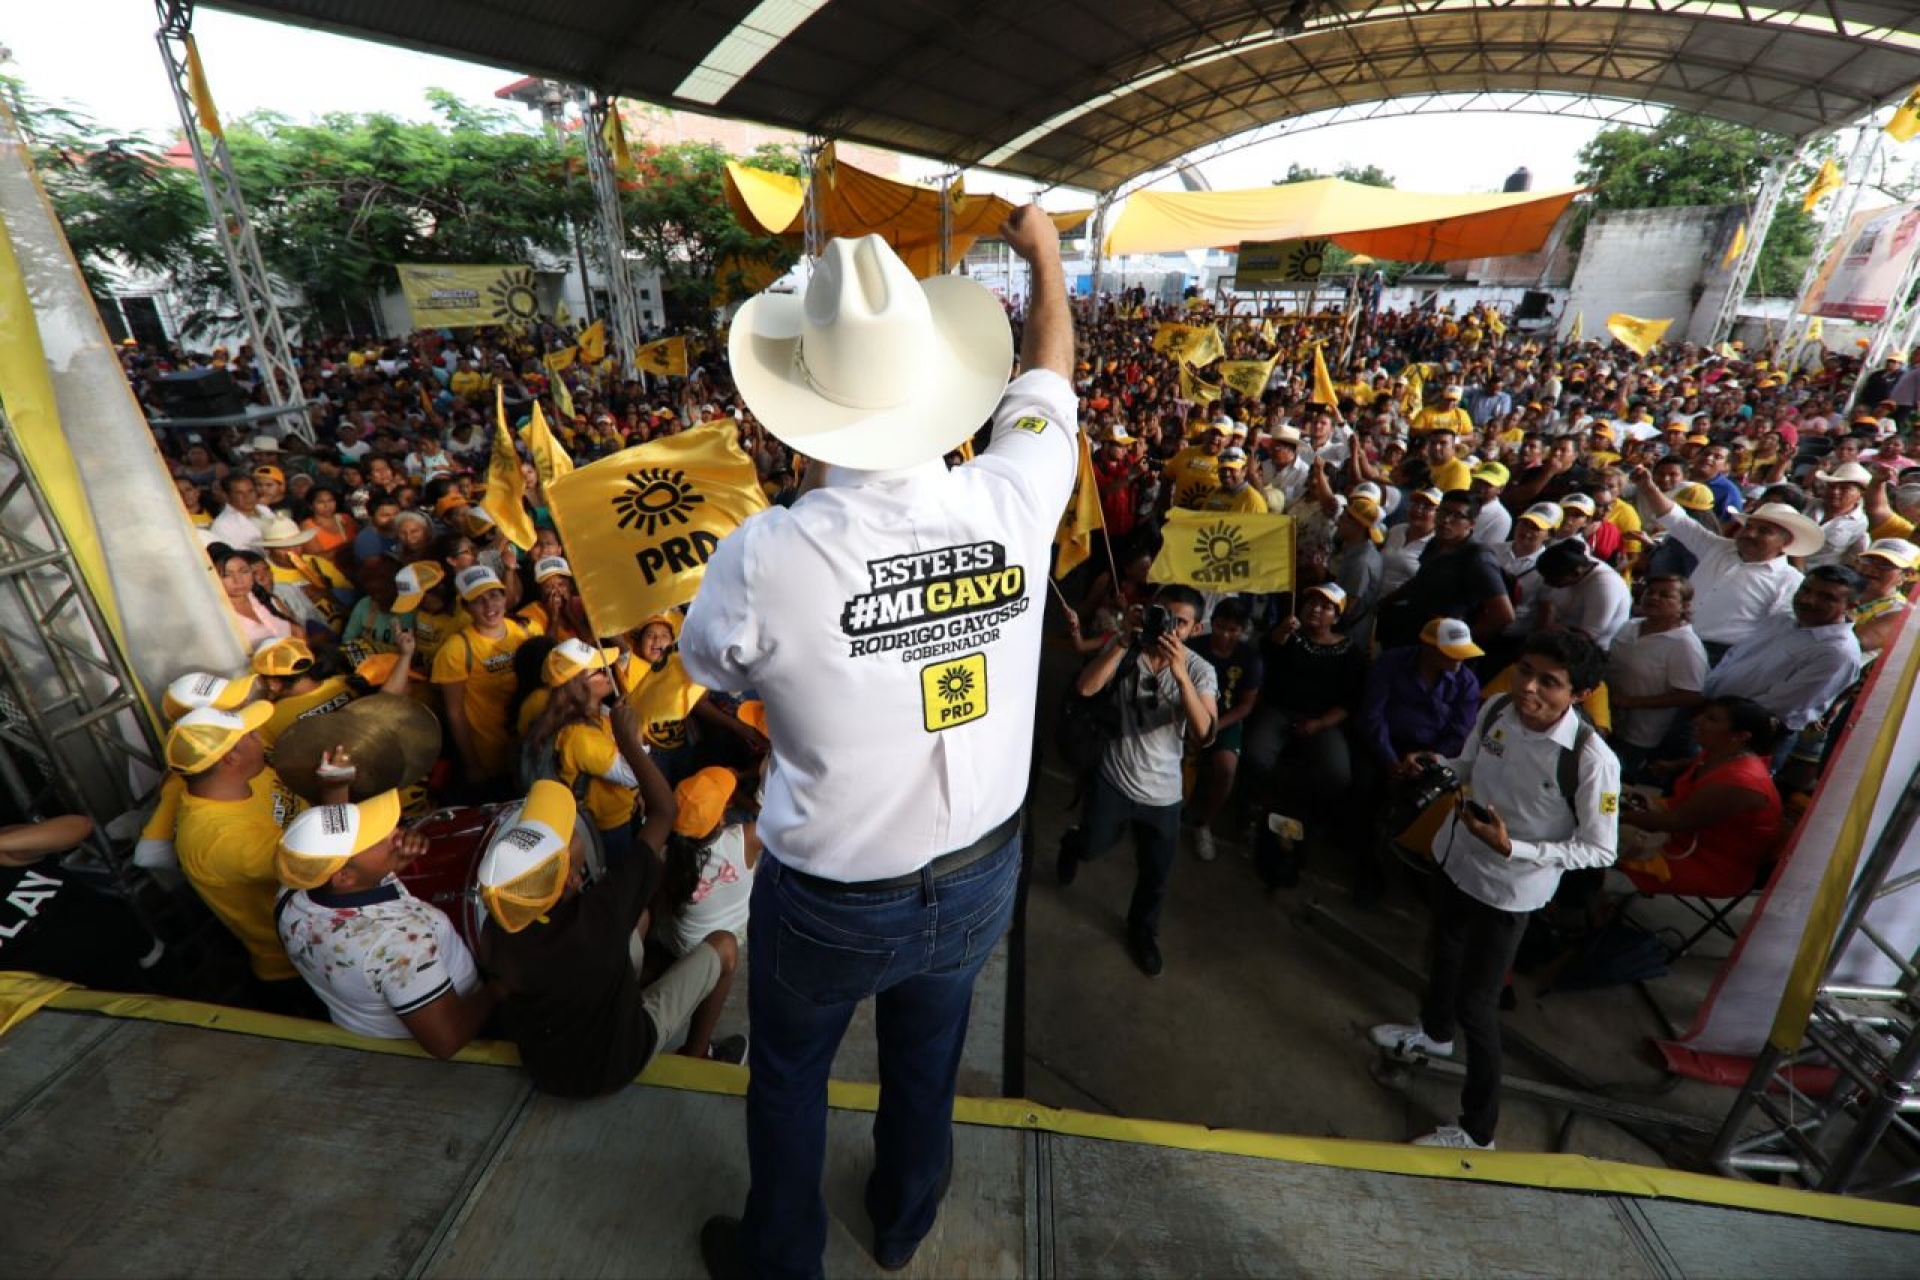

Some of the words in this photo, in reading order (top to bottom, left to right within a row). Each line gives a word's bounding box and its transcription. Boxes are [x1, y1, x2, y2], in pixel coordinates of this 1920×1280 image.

[636, 531, 719, 585] PRD
[870, 549, 950, 589] ESTE
[953, 543, 994, 573] ES
[849, 623, 945, 658] RODRIGO
[948, 597, 1030, 637] GAYOSSO
[902, 628, 1000, 663] GOBERNADOR
[941, 701, 974, 723] PRD
[0, 870, 63, 948] LAY
